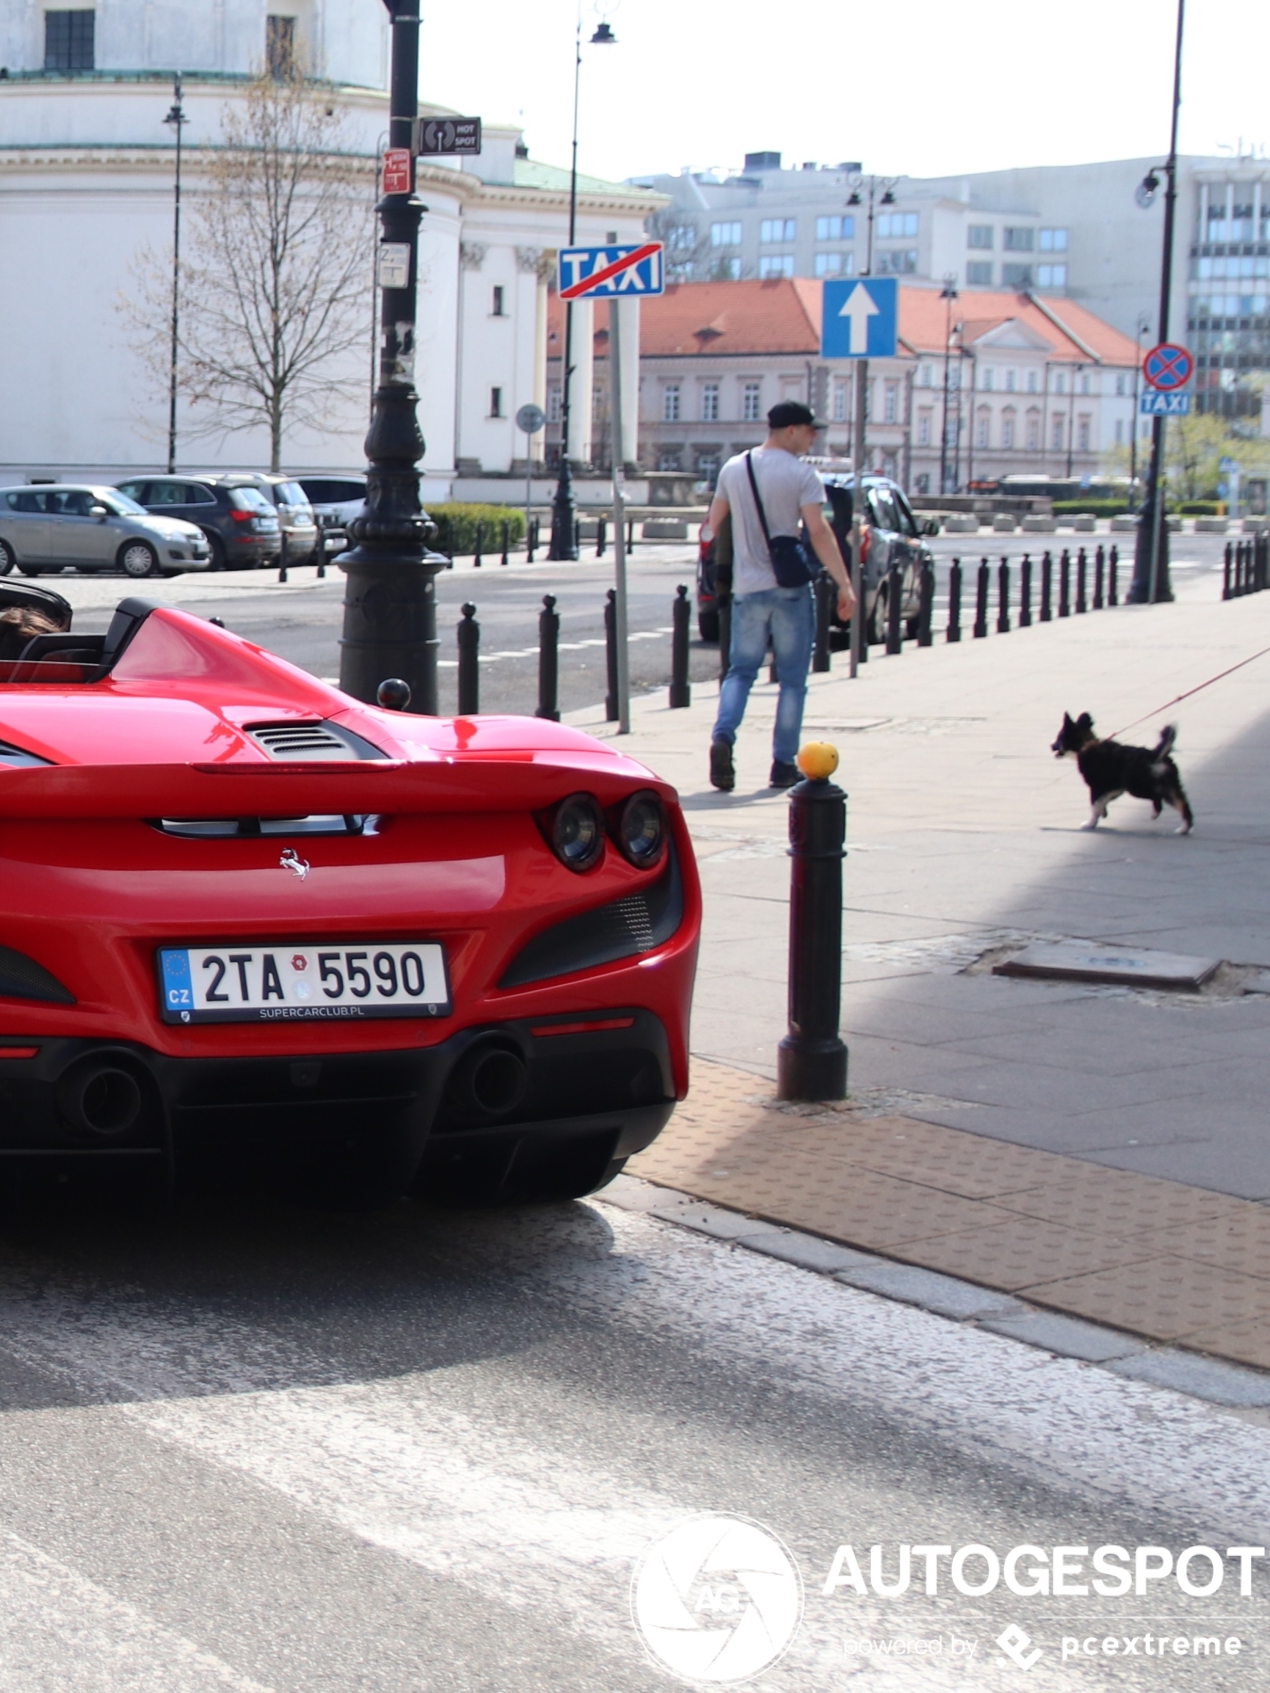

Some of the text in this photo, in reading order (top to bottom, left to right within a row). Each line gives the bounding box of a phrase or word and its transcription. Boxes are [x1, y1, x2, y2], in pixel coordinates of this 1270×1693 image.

[457, 124, 475, 134] HOT
[455, 136, 476, 146] SPOT
[562, 250, 659, 292] TAXI
[1143, 393, 1188, 411] TAXI
[202, 951, 425, 1002] 2TA 5590
[169, 989, 190, 1004] CZ
[259, 1006, 365, 1018] SUPERCARCLUB.PL
